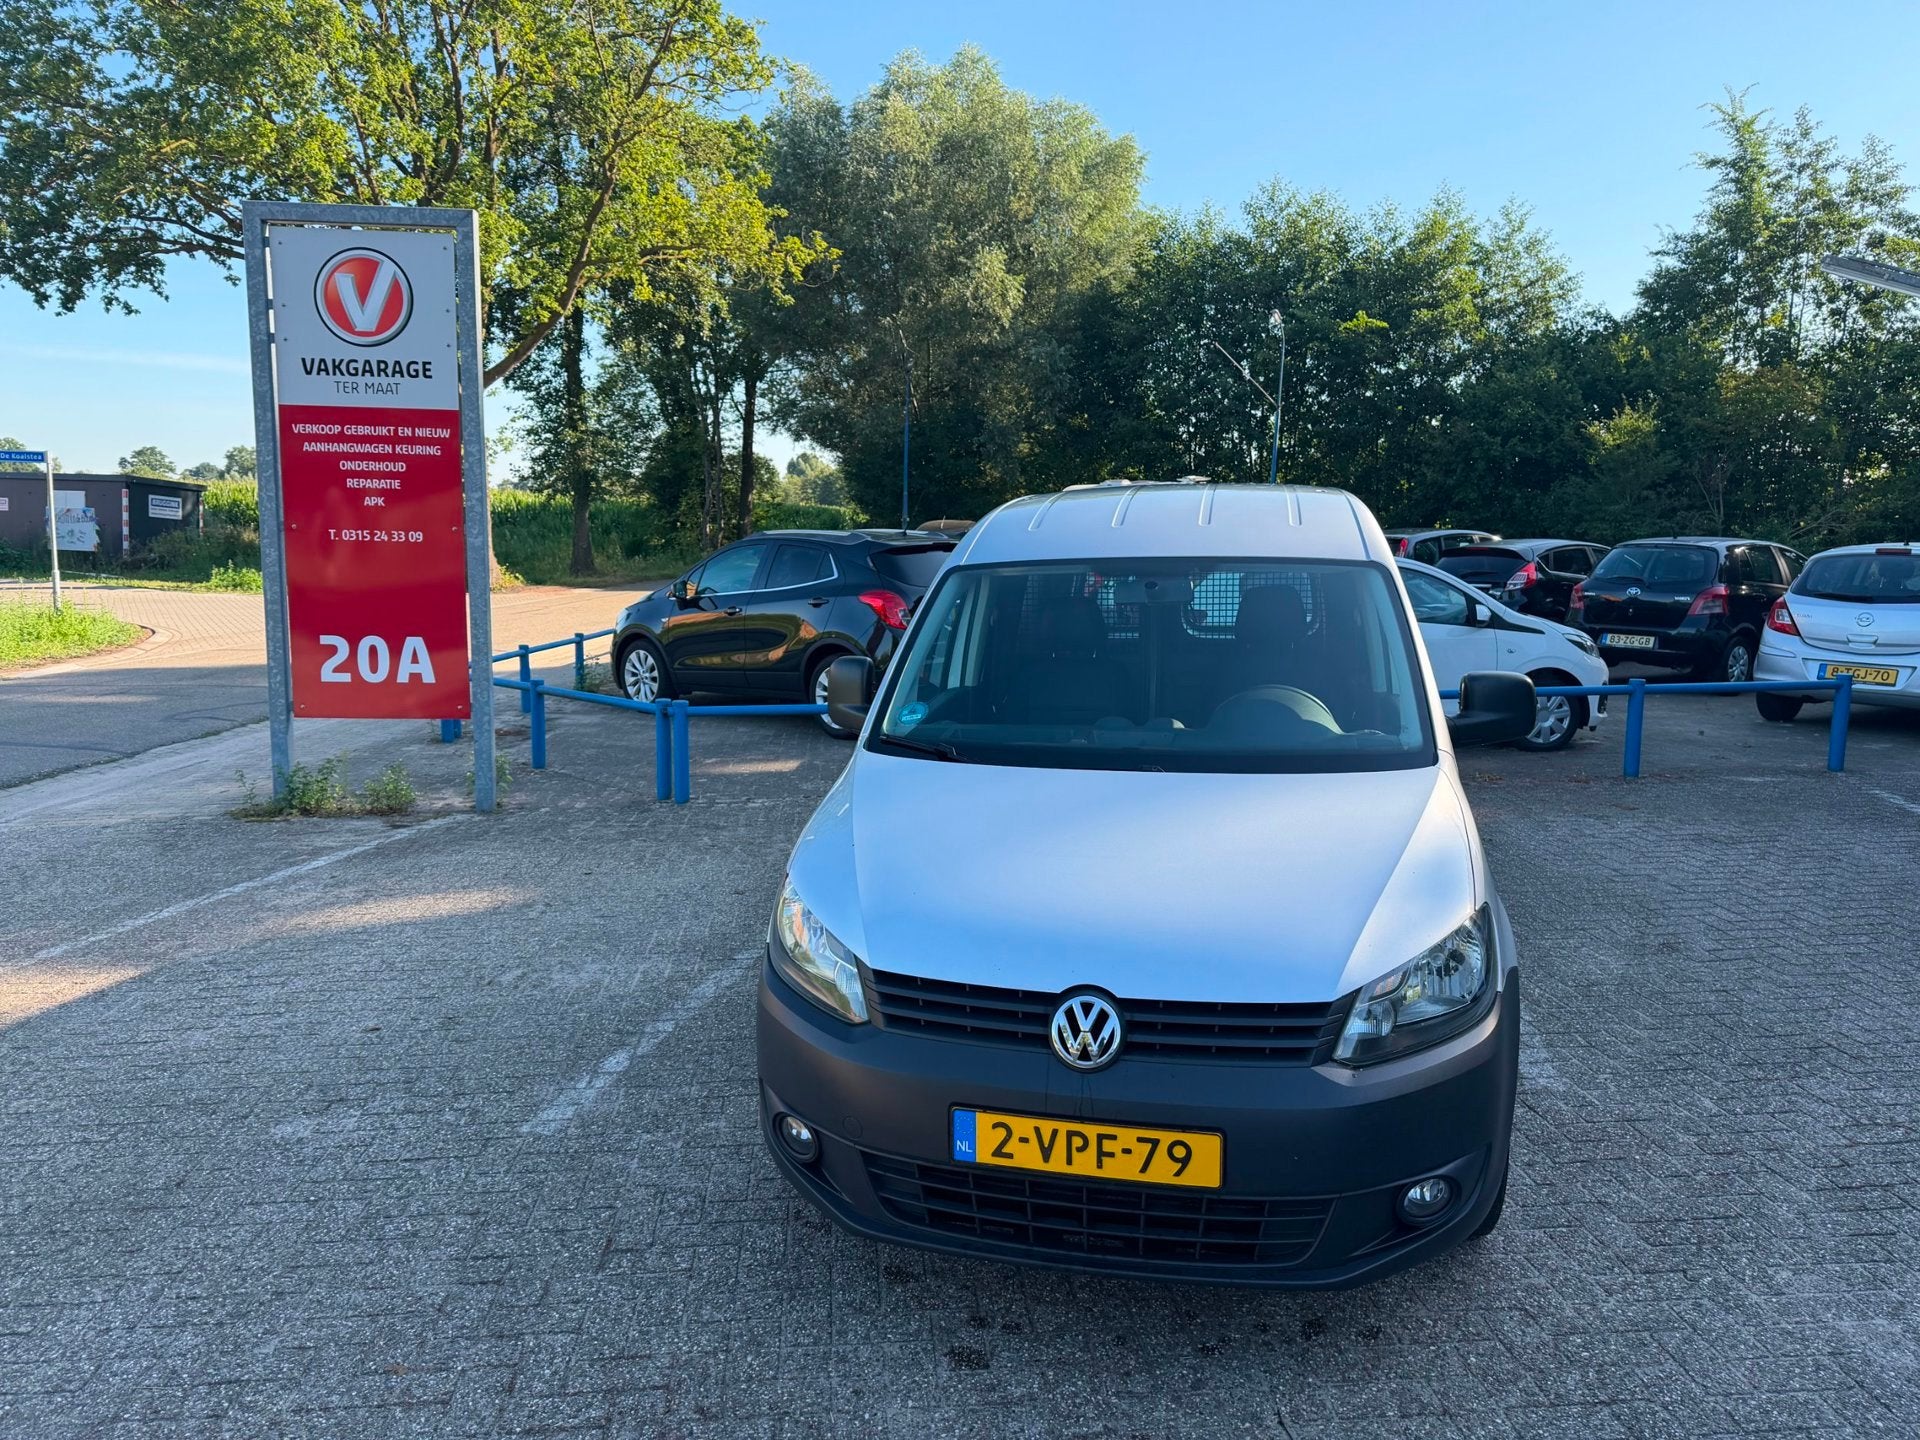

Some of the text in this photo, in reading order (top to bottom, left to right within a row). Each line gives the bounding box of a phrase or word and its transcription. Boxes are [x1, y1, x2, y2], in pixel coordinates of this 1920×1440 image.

[301, 357, 433, 379] VAKGARAGE
[334, 381, 401, 395] TER MAAT
[291, 423, 451, 438] VERKOOP GEBRUIKT EN NIEUW
[303, 441, 441, 456] AANHANGWAGEN KEURING
[339, 460, 406, 472] ONDERHOUD
[346, 478, 401, 489] REPARATIE
[364, 496, 385, 507] APK
[328, 529, 423, 542] T. 0315 24 33 09
[319, 634, 436, 684] 20A
[956, 1121, 1193, 1177] NL 2-VPF-79
